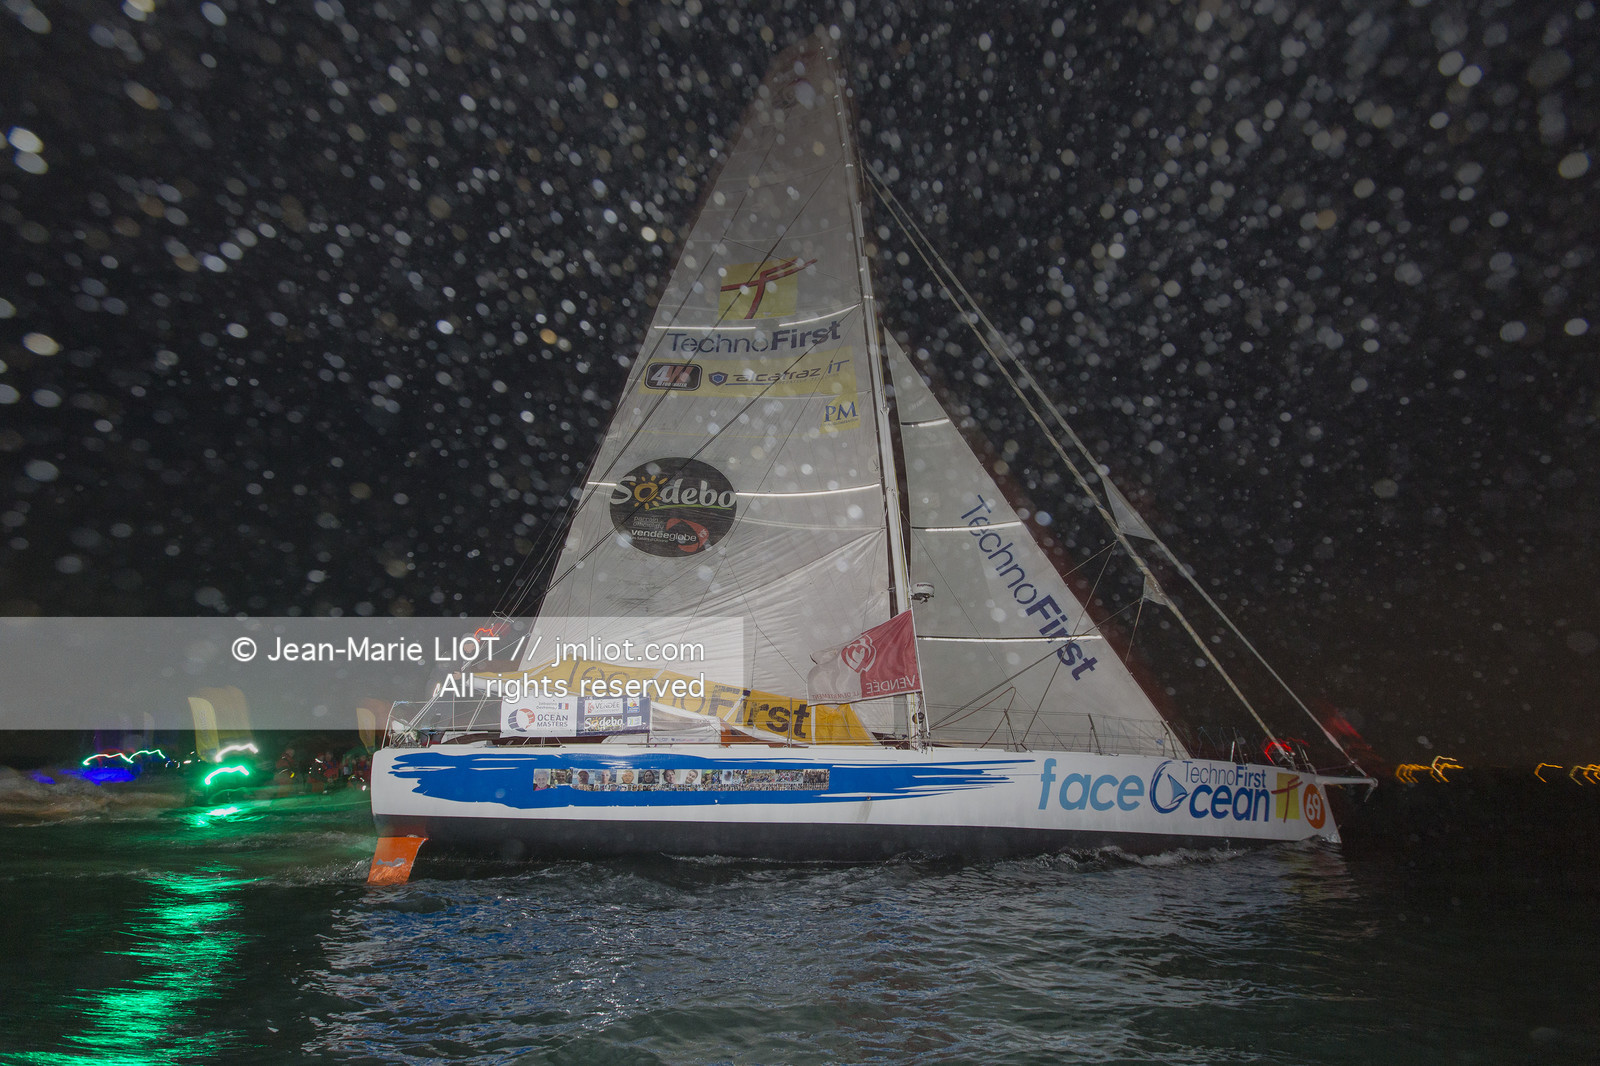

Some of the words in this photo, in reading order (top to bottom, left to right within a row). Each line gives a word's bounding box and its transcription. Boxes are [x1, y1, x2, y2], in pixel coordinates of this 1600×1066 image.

[667, 320, 841, 353] TechnoFirst
[824, 401, 858, 422] PM
[610, 475, 738, 508] Sodebo
[961, 494, 1098, 681] TechnoFirst
[537, 714, 568, 722] OCEAN
[584, 715, 624, 730] Sodebo
[1038, 758, 1145, 811] face
[1183, 760, 1267, 788] TechnoFirst
[1306, 793, 1321, 820] 69
